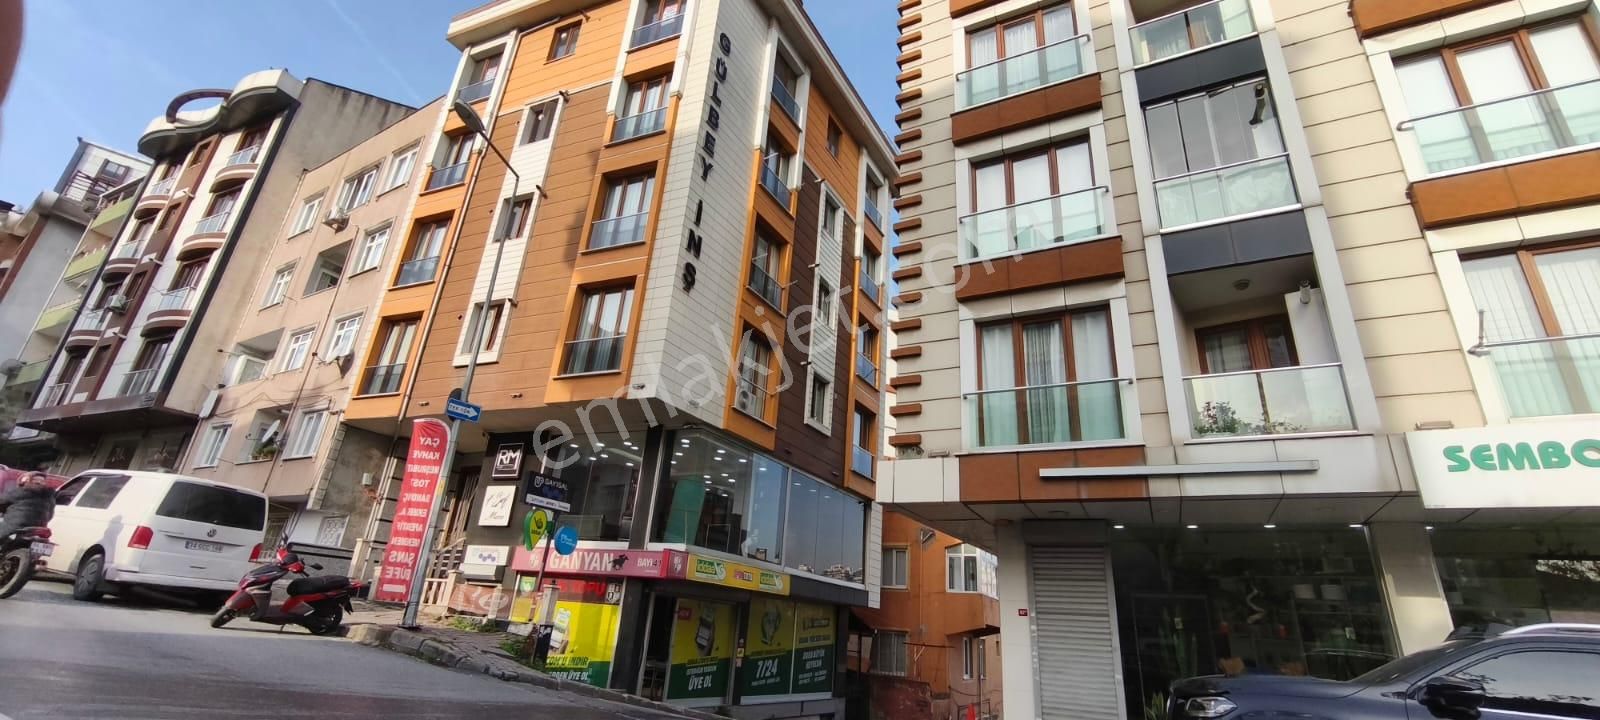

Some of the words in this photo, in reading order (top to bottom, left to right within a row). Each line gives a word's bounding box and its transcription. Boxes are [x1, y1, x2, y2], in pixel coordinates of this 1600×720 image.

[700, 32, 732, 182] GÜLBEY
[1443, 438, 1600, 472] SEMBO
[550, 552, 614, 572] GANYAN
[756, 658, 778, 679] 7/24
